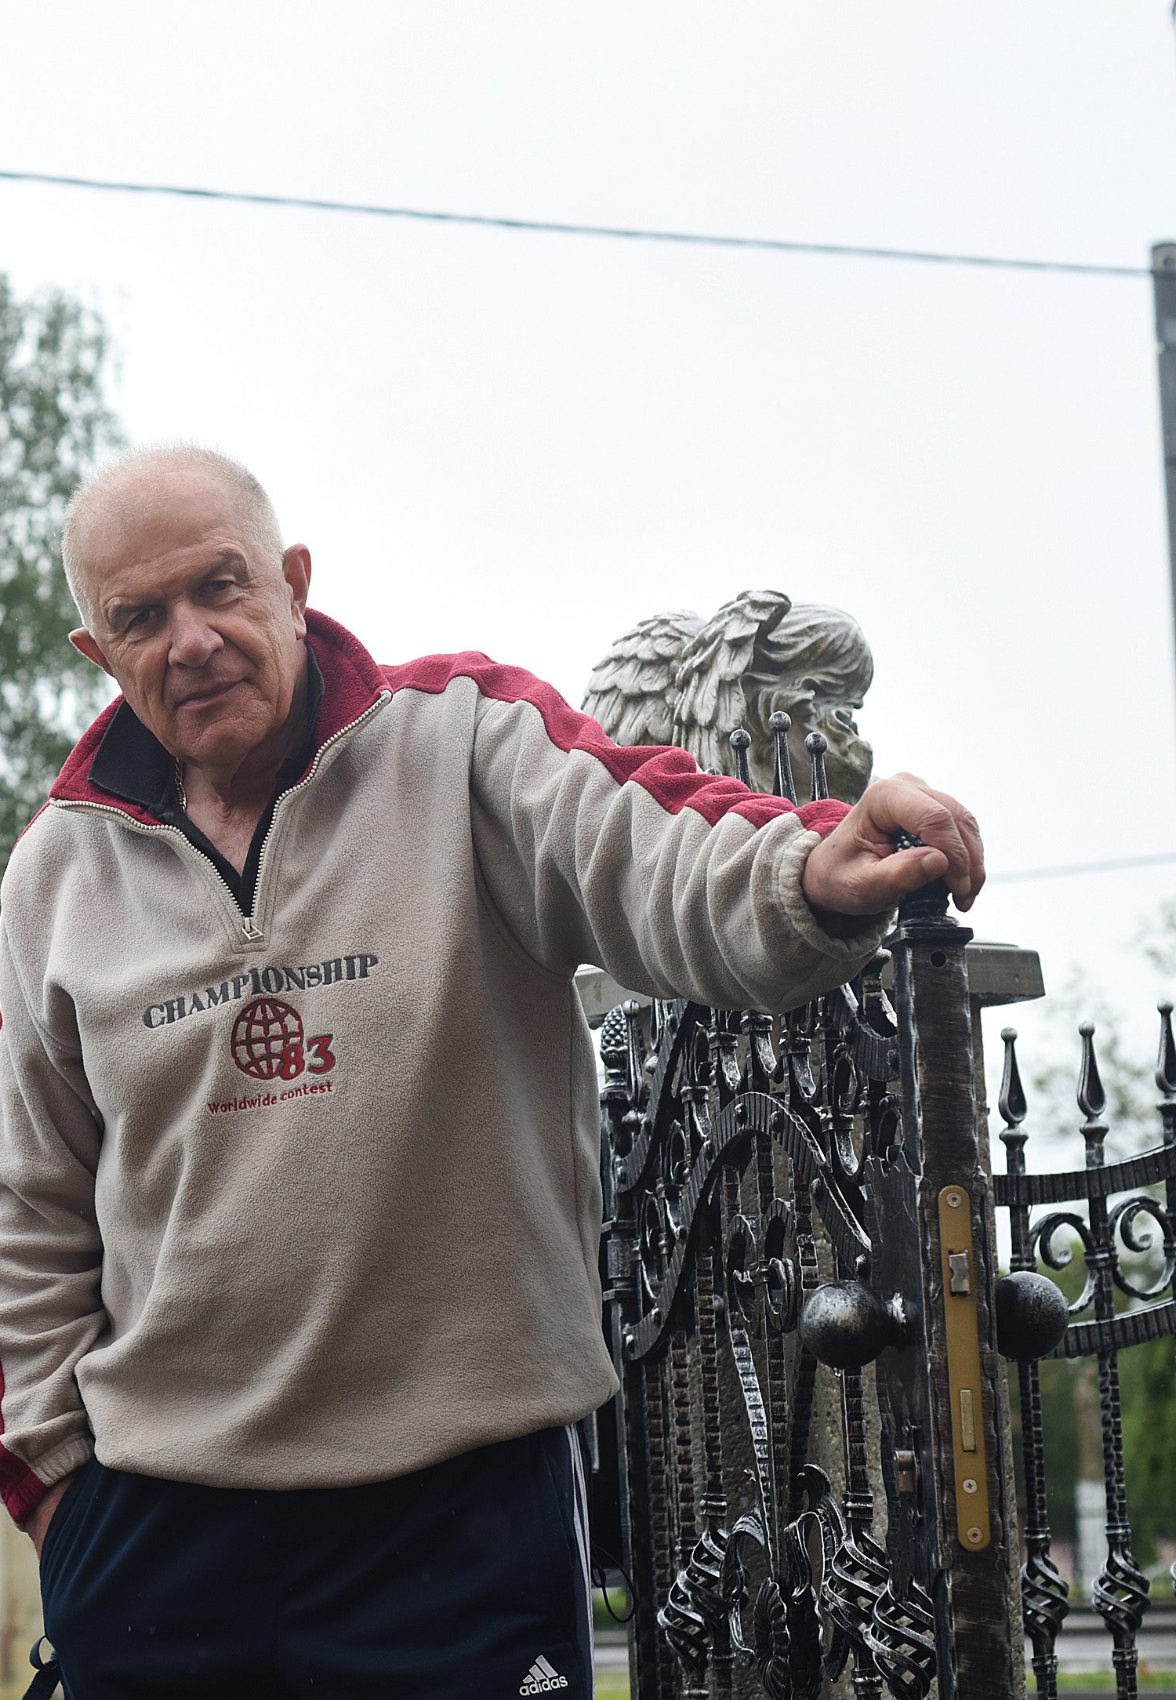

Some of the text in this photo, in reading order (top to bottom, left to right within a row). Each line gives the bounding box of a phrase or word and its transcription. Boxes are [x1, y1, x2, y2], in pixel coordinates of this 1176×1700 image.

[142, 954, 378, 1028] CHAMPIONSHIP
[278, 1034, 336, 1081] 83
[207, 1081, 333, 1114] Worldwide contest
[519, 1676, 568, 1696] adidas
